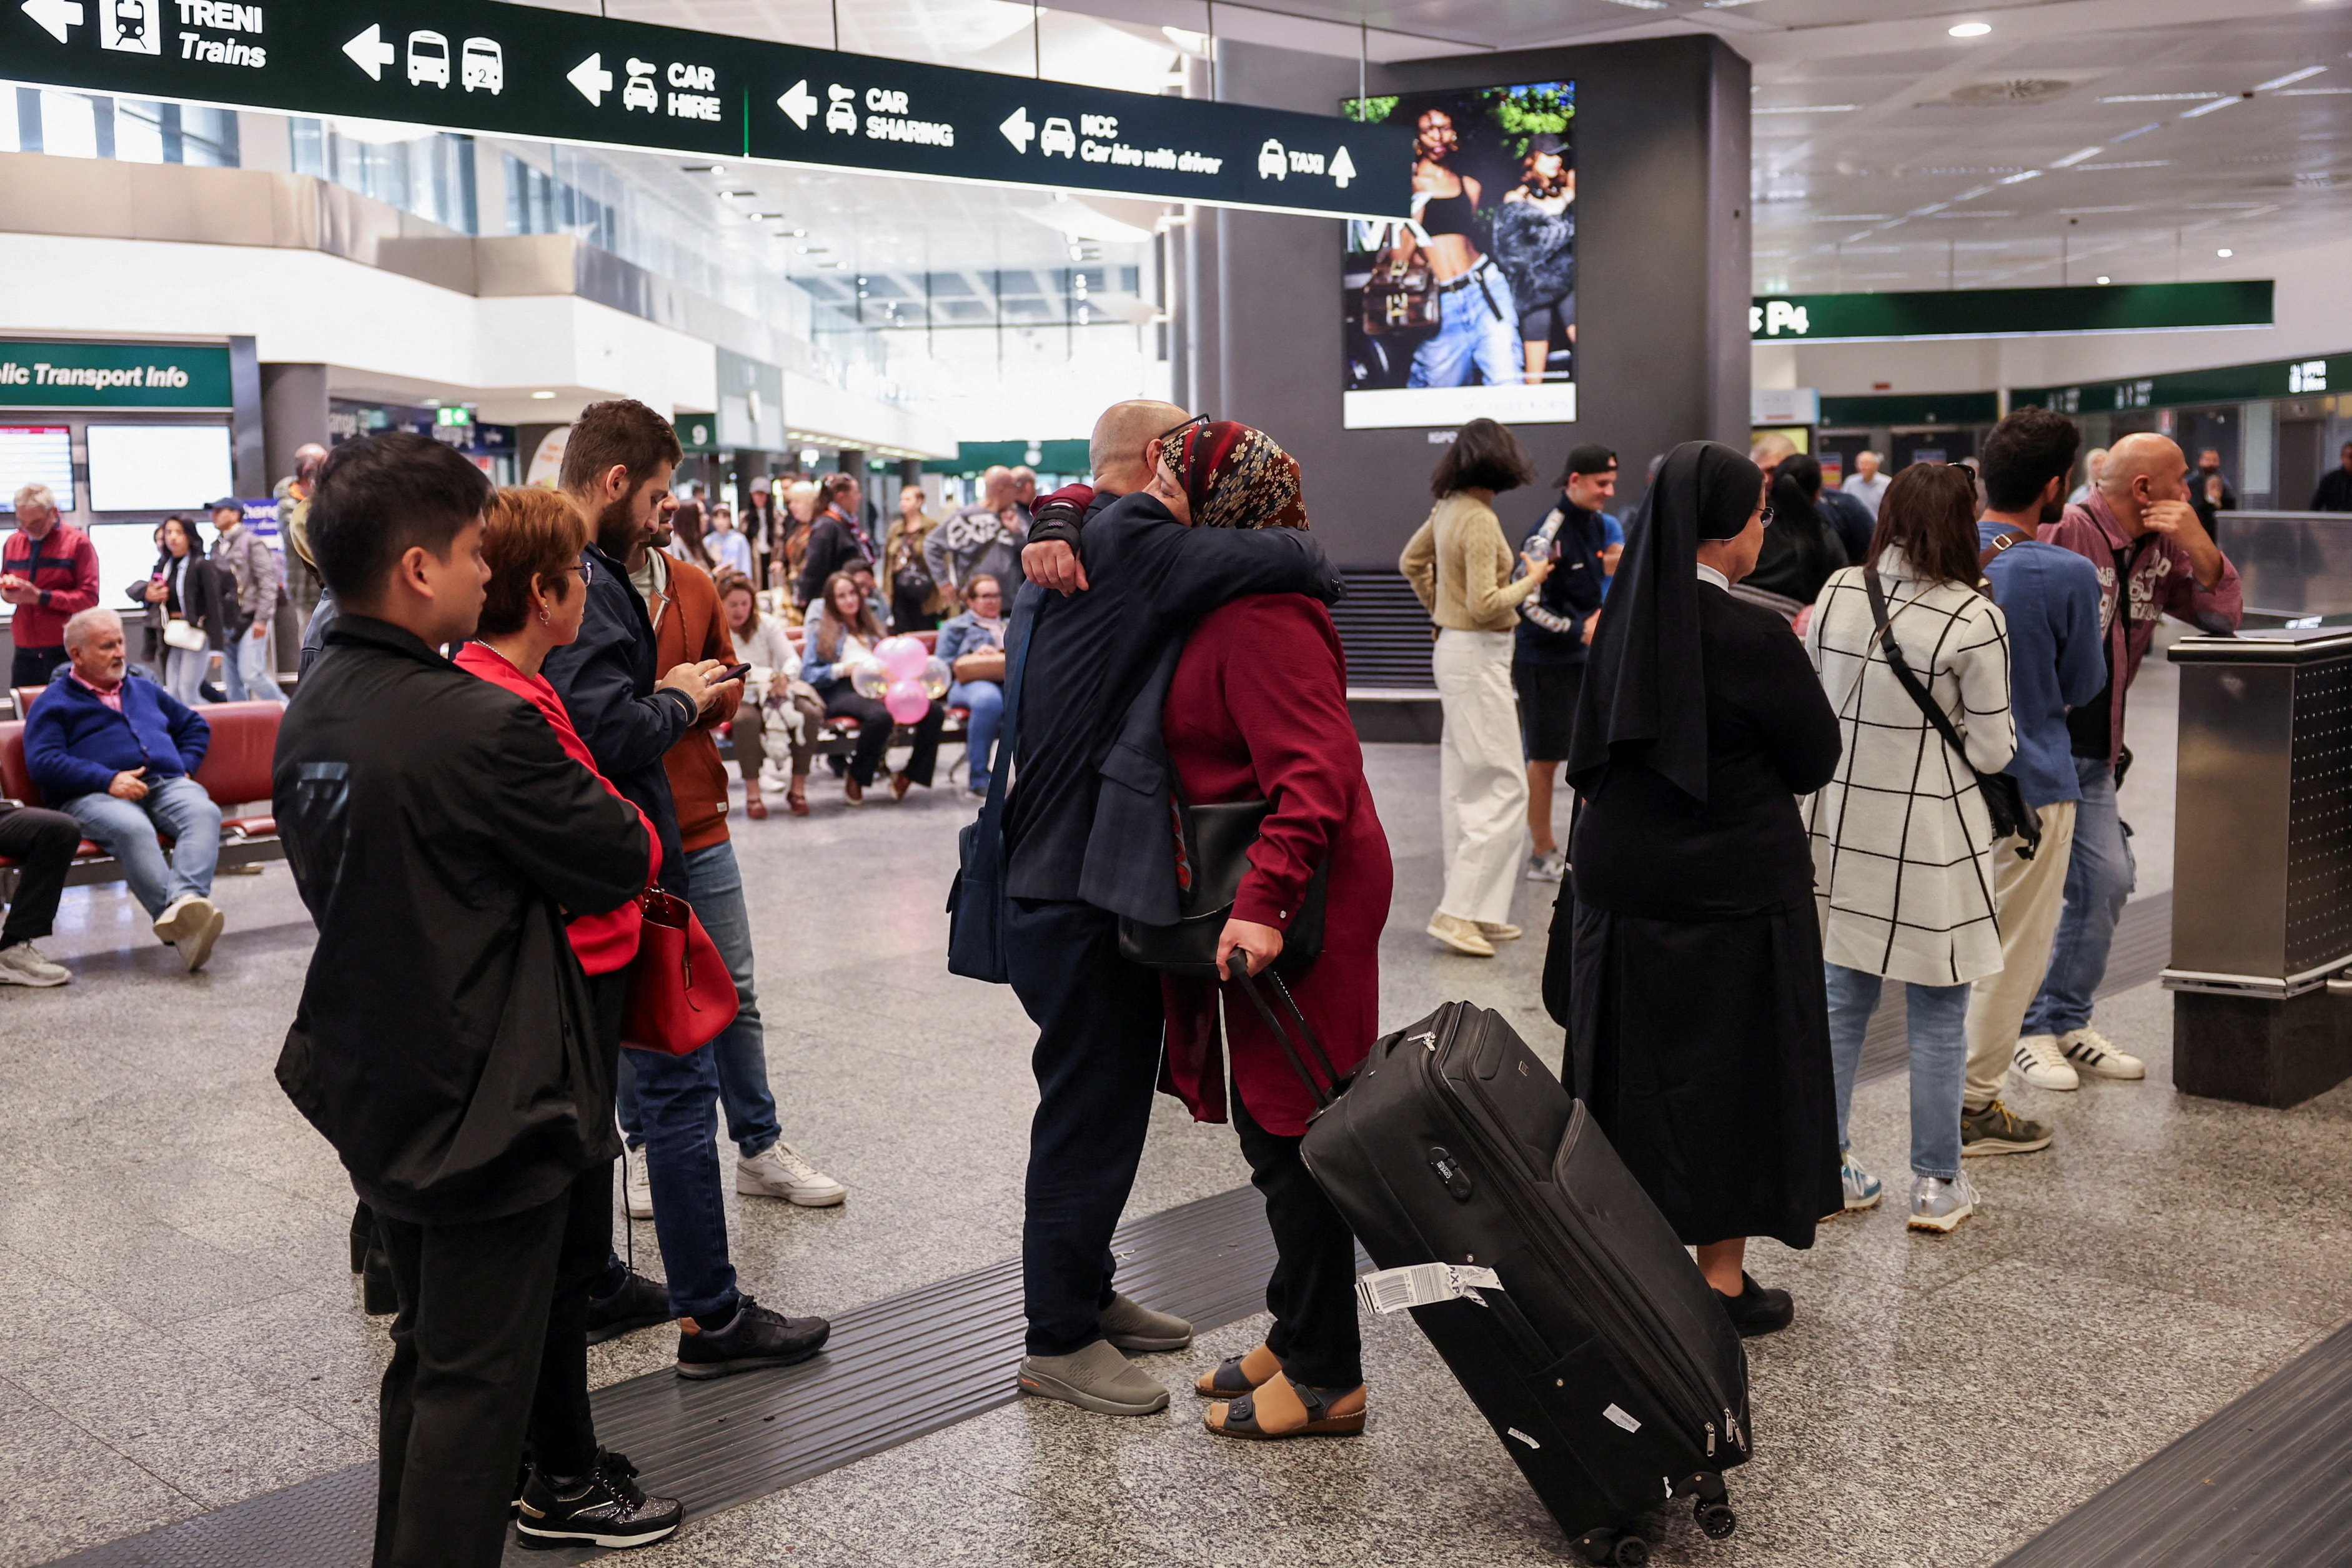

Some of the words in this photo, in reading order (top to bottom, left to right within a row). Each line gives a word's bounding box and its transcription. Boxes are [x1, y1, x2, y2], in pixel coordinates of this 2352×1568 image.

[174, 0, 262, 34] TRENI
[179, 32, 267, 68] Trains
[667, 62, 715, 91] CAR
[668, 92, 721, 121] HIRE
[866, 87, 908, 114] CAR
[866, 116, 954, 147] SHARING
[1081, 114, 1118, 139] NCC
[1080, 139, 1112, 163] Car
[1111, 143, 1143, 166] hire
[1144, 148, 1177, 169] with
[1177, 151, 1223, 174] driver
[1288, 151, 1324, 174] TAXI
[1766, 301, 1810, 335] P4
[0, 362, 30, 385] lic
[34, 363, 143, 390] Transport
[146, 365, 189, 388] Info
[692, 424, 708, 446] 9
[1437, 1161, 1451, 1179] COVERI
